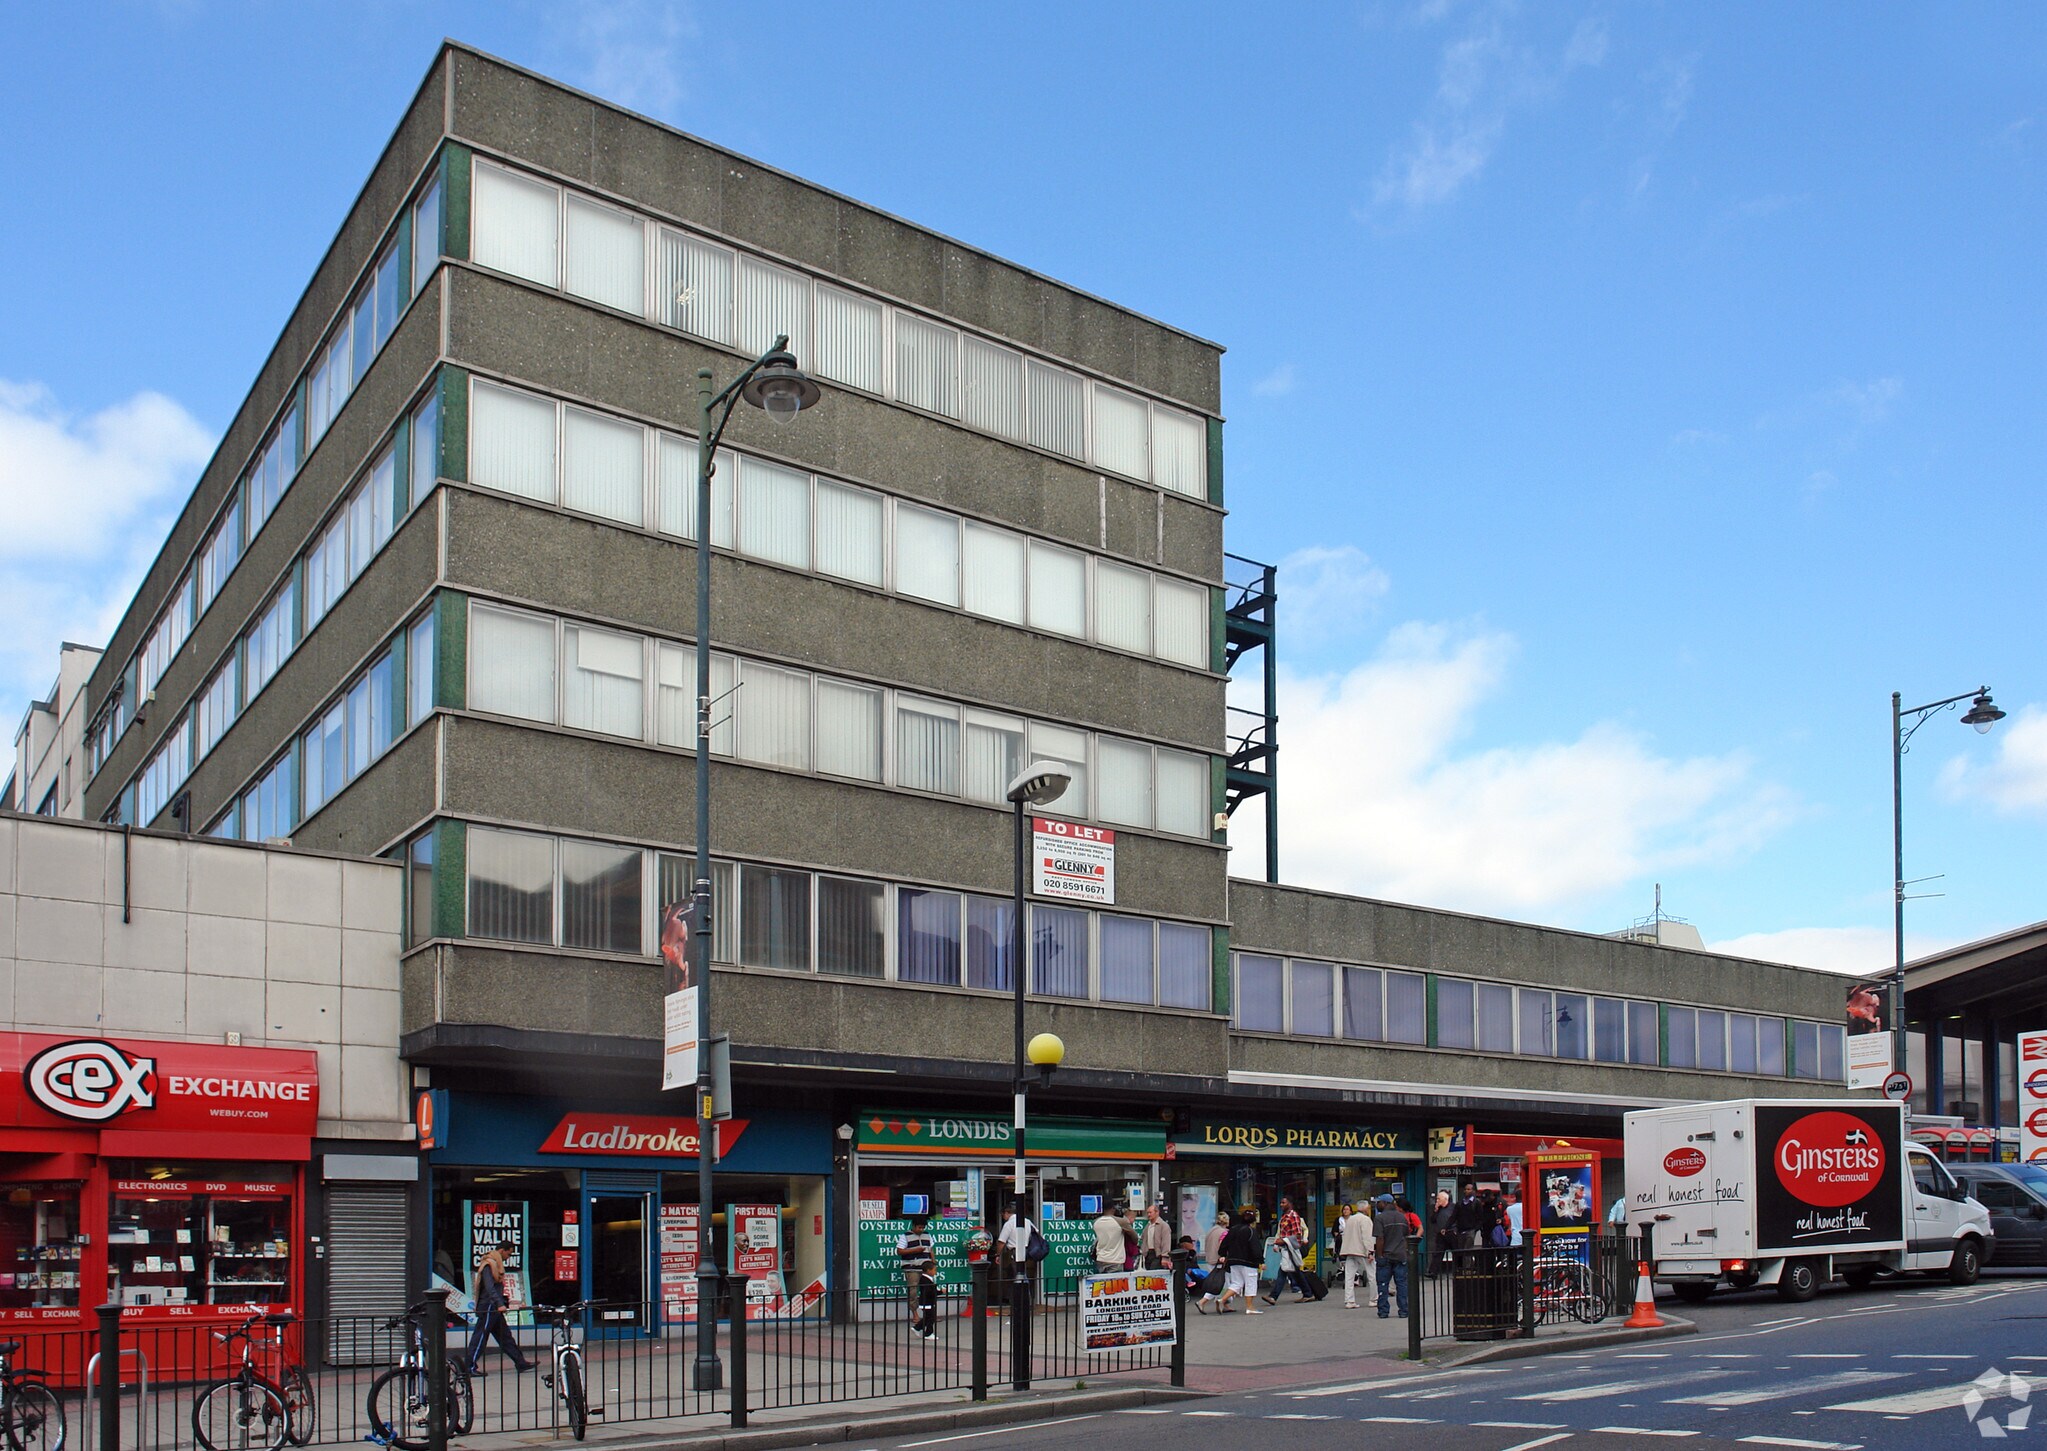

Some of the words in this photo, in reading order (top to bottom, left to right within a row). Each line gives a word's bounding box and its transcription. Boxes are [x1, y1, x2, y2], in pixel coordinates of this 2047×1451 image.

[1045, 821, 1067, 834] TO
[1074, 826, 1104, 840] LET
[1054, 859, 1095, 875] GLENNY
[1043, 879, 1060, 889] 020
[1062, 881, 1084, 892] 8591
[1085, 885, 1105, 895] 6671
[169, 1076, 310, 1101] EXCHANGE
[209, 1108, 269, 1119] WEBUY.COM
[422, 1097, 429, 1131] L
[928, 1118, 1010, 1141] LONDIS
[1205, 1125, 1278, 1151] LORDS
[1286, 1128, 1398, 1149] PHARMACY
[1432, 1155, 1462, 1163] Pharmacy
[1665, 1156, 1705, 1170] GINSTERS
[1781, 1139, 1879, 1179] GINSTERS
[1817, 1173, 1827, 1183] of
[1828, 1172, 1869, 1183] Cornwall
[118, 1182, 188, 1191] ELECTRONICS
[206, 1183, 226, 1191] DVD
[244, 1184, 276, 1192] MUSIC
[1636, 1184, 1657, 1203] real
[1668, 1181, 1705, 1202] honest
[1715, 1178, 1739, 1206] food
[668, 1206, 700, 1216] MATCH!
[735, 1207, 755, 1216] FIRST
[757, 1207, 777, 1216] GOAL!
[862, 1202, 870, 1210] WE
[871, 1201, 884, 1210] SELL
[473, 1213, 521, 1228] GREAT
[860, 1209, 886, 1219] STAMPS
[1796, 1210, 1813, 1230] real
[1816, 1208, 1845, 1229] honest
[1845, 1207, 1865, 1234] food
[860, 1221, 906, 1231] OYSTER
[936, 1221, 973, 1231] PASSES
[1048, 1221, 1076, 1230] NEWS
[1077, 1221, 1086, 1230] &
[473, 1229, 521, 1244] VALUE
[1042, 1233, 1070, 1242] COLD
[1071, 1233, 1080, 1242] &
[473, 1255, 520, 1268] CON!
[862, 1260, 885, 1269] FAX
[1091, 1277, 1129, 1298] FUN
[1135, 1276, 1168, 1291] FAIR
[1085, 1296, 1138, 1308] BARKING
[1140, 1293, 1171, 1304] PARK
[14, 1311, 34, 1319] SELL
[123, 1308, 144, 1317] BUY
[169, 1307, 193, 1315] SELL
[1087, 1315, 1110, 1324] FRIDAY
[1131, 1311, 1143, 1319] SUN
[1155, 1308, 1170, 1317] SEPT
[1096, 1306, 1141, 1314] LONGBRIDGE
